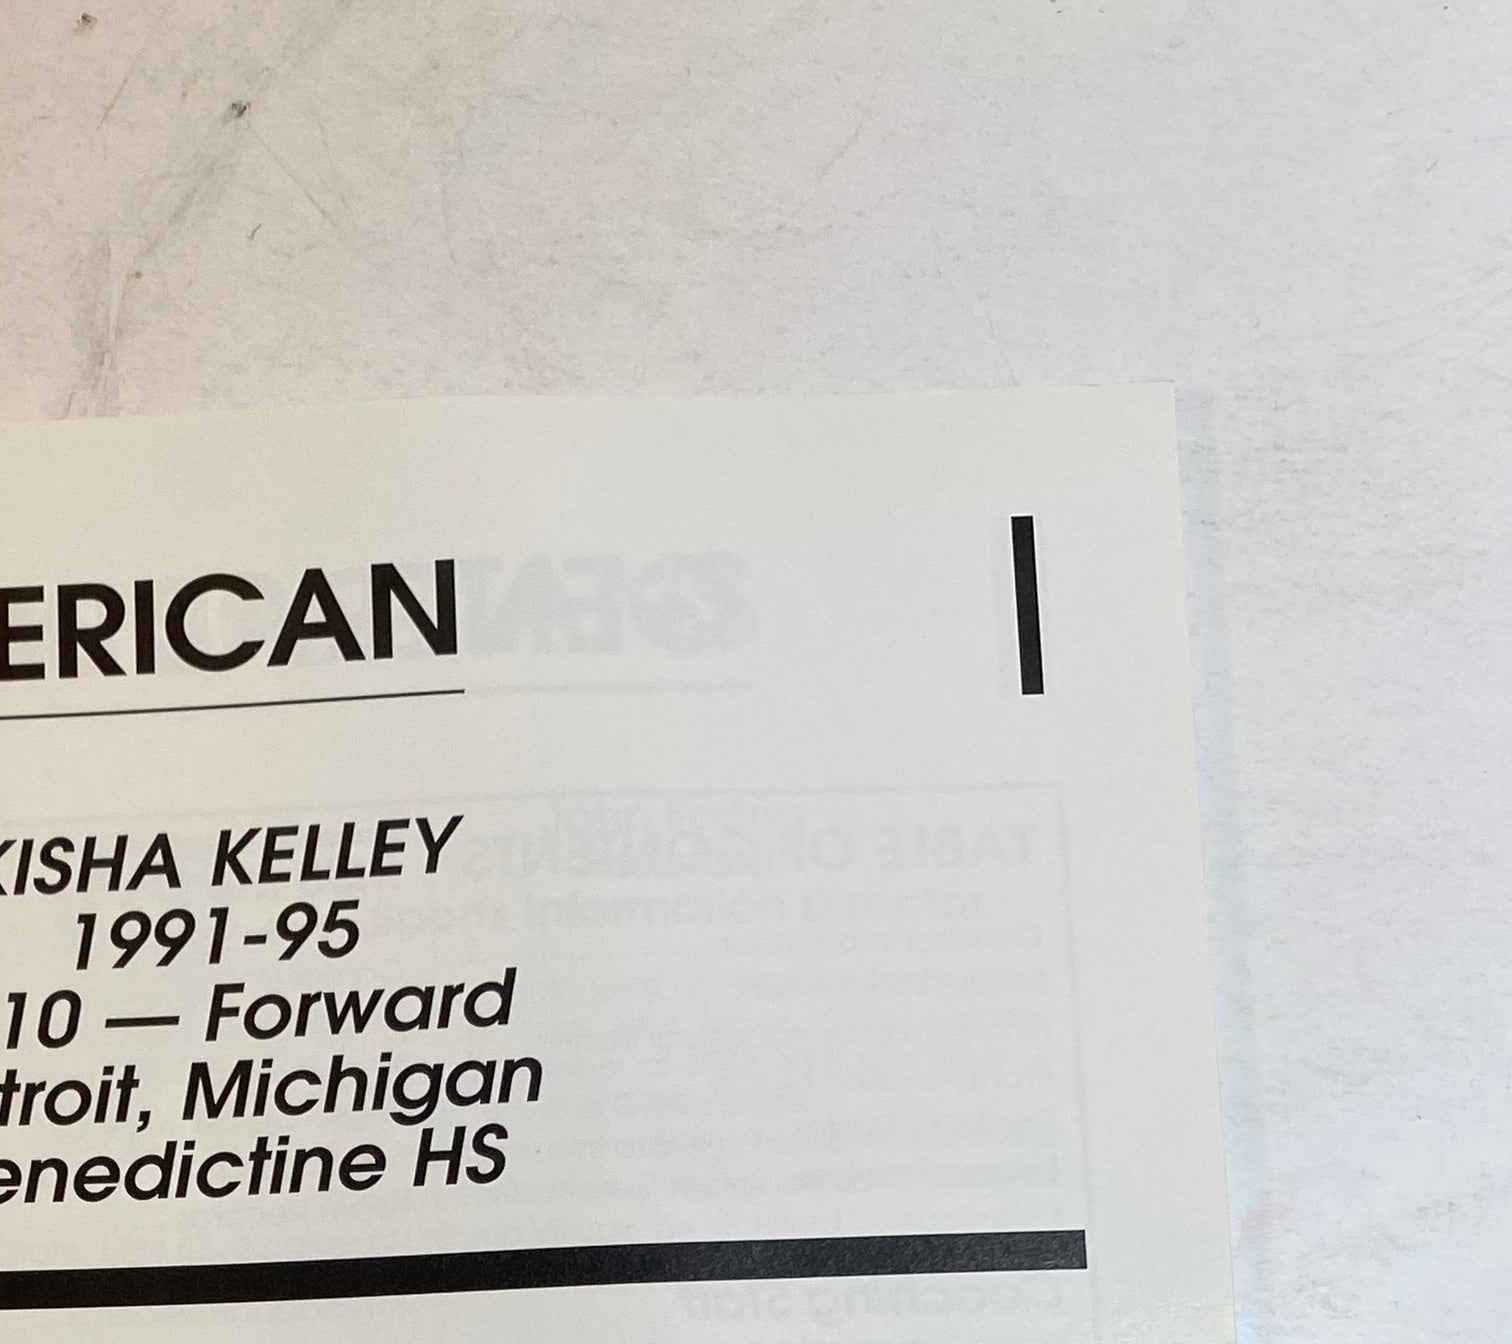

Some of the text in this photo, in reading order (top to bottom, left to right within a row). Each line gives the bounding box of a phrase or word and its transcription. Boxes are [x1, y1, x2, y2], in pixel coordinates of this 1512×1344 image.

[212, 815, 464, 886] KELLEY
[77, 899, 359, 970] 1991-95
[205, 967, 517, 1041] Forward
[182, 1052, 542, 1126] Michigan
[413, 1123, 508, 1187] HS
